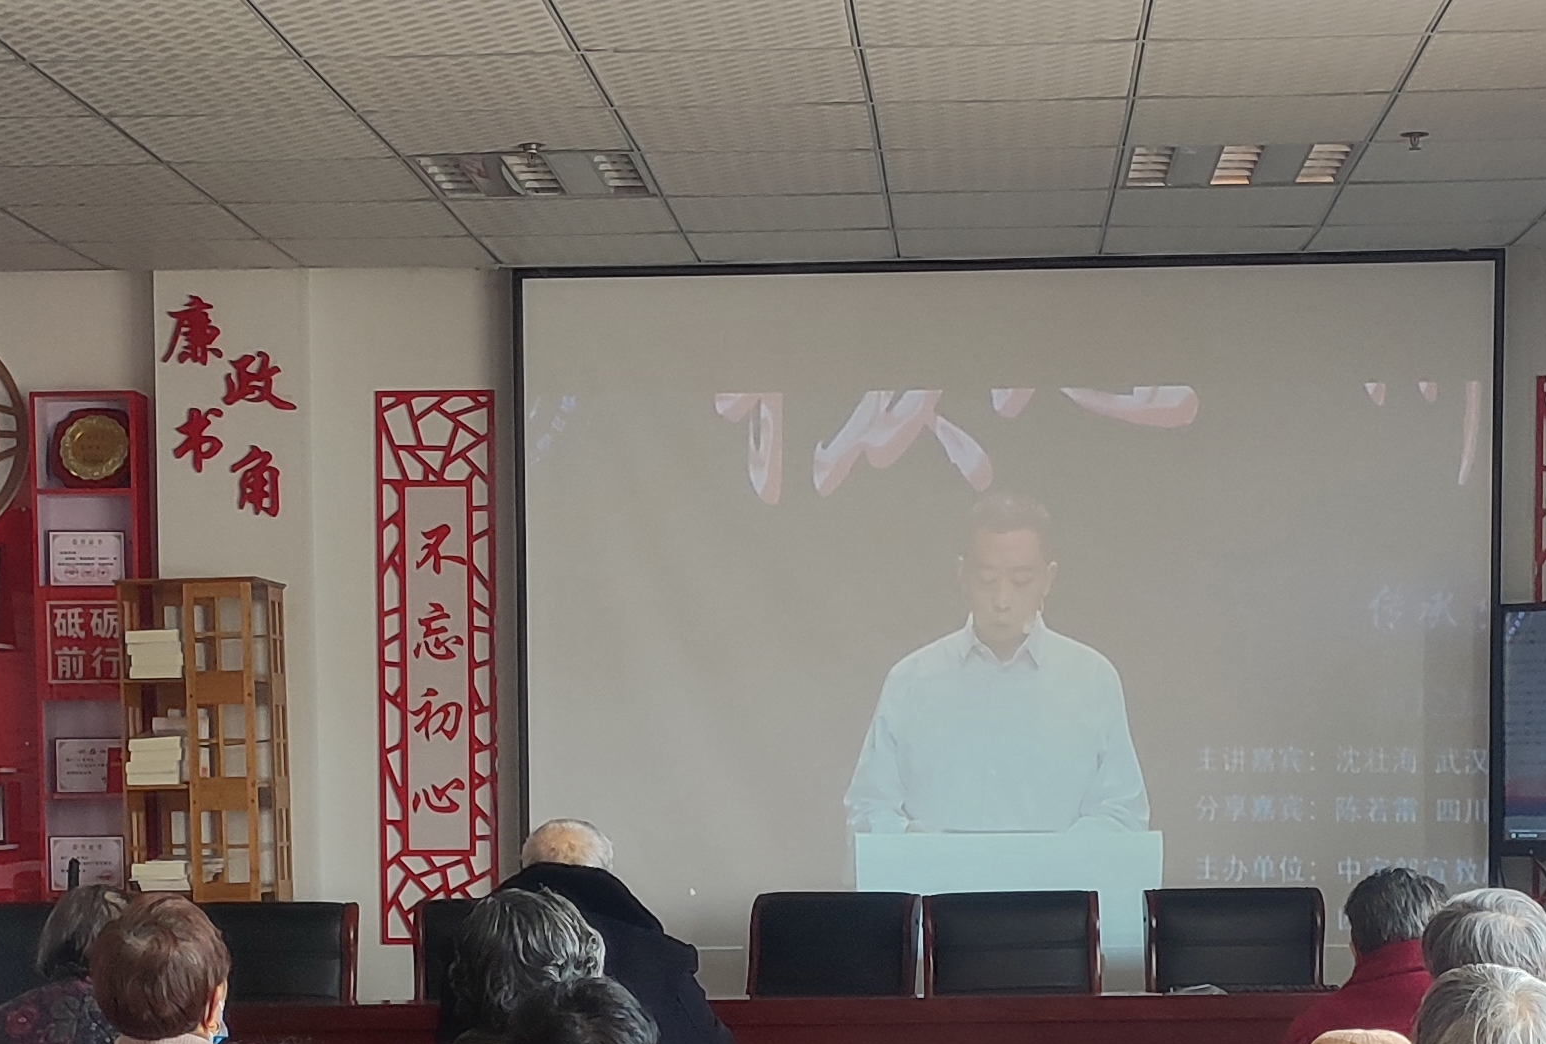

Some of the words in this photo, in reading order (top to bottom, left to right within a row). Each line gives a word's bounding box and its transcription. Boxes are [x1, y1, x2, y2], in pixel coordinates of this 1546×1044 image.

[53, 607, 120, 640] 砥砺
[55, 646, 120, 680] 前行
[409, 523, 468, 814] 不忘初心
[1434, 747, 1488, 774] 武汉
[1435, 797, 1488, 823] 四川
